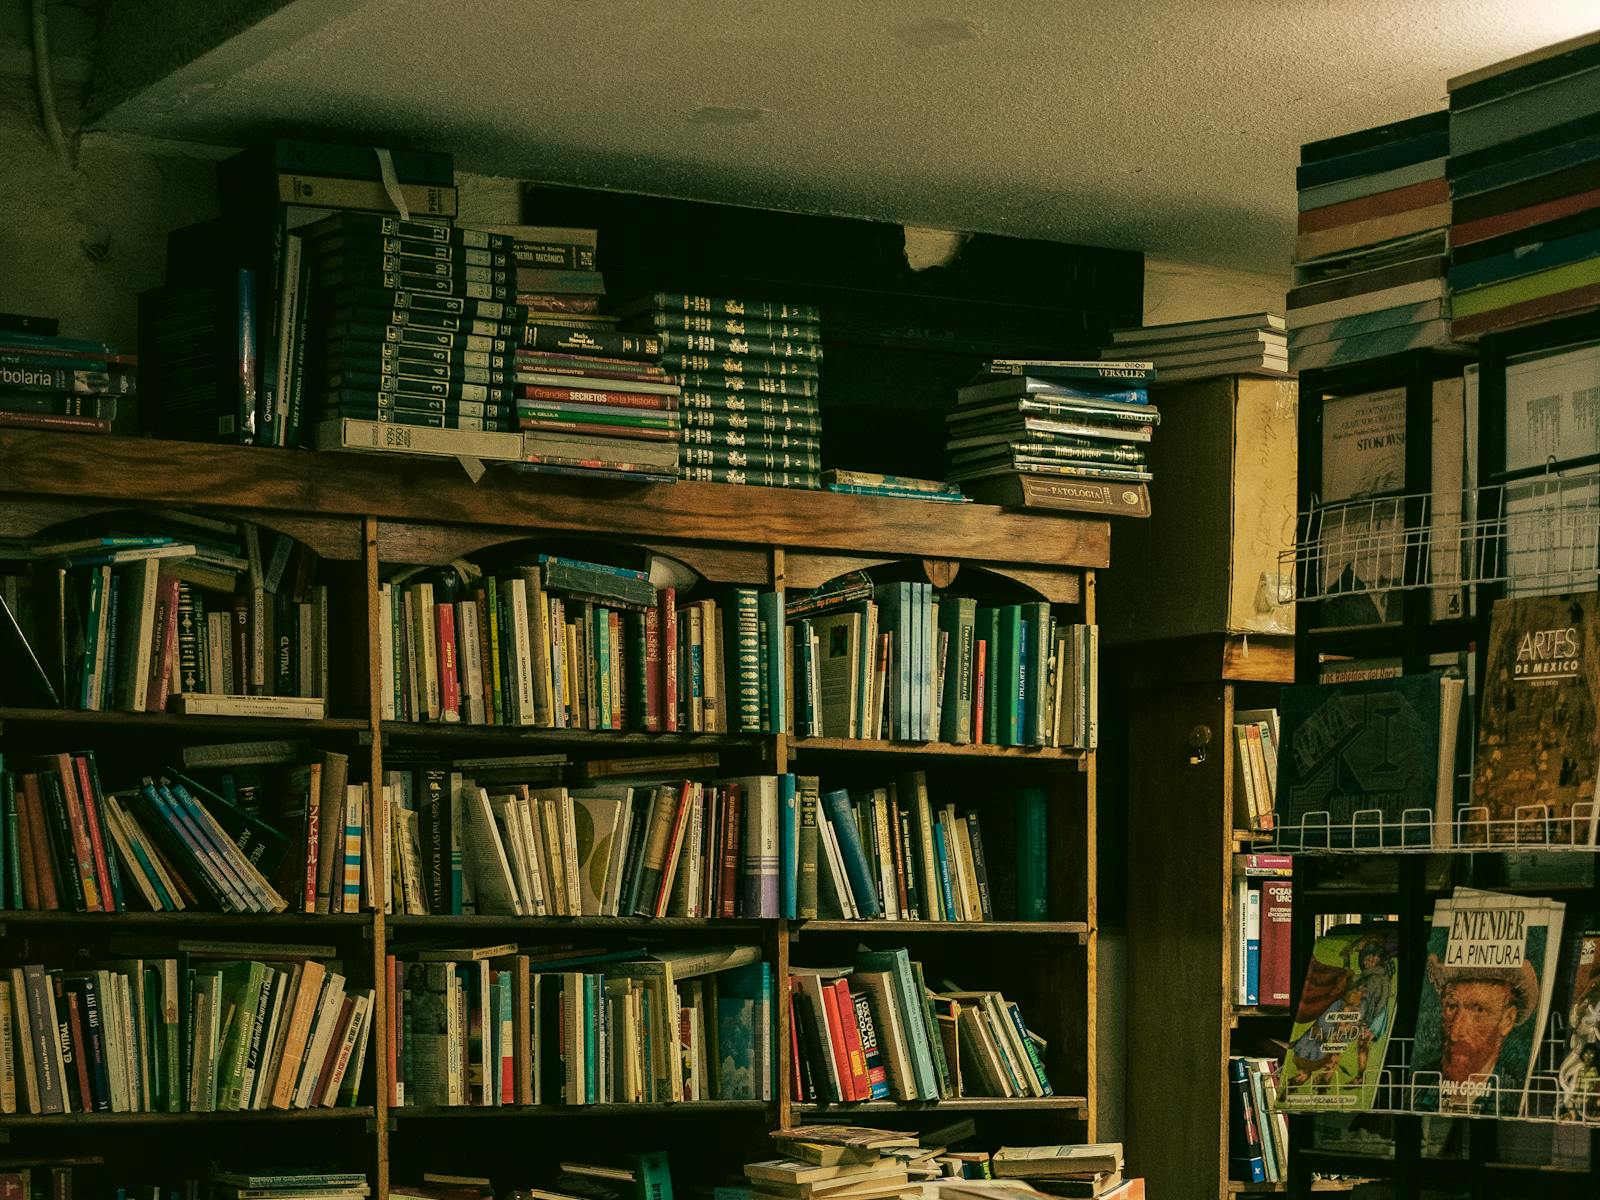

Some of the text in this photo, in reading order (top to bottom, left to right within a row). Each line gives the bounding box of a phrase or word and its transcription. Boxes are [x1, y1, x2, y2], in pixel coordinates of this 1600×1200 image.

[433, 229, 444, 240] 12
[435, 247, 446, 258] 11
[436, 264, 447, 275] 10
[437, 336, 448, 344] 6
[434, 352, 444, 360] 5
[434, 368, 444, 376] 4
[1098, 369, 1146, 379] VERSALLES
[535, 390, 569, 400] Grandes
[569, 391, 607, 403] SECRETOS
[626, 396, 658, 406] Historia
[963, 625, 971, 652] Tratado
[1516, 628, 1576, 661] ARTES
[280, 636, 289, 675] EL VITRAL
[1514, 660, 1579, 674] DE MEXICO
[431, 792, 441, 908] LA FUERZA DE LAS PALABRAS
[1450, 910, 1525, 941] ENTENDER
[1447, 945, 1521, 965] LA PINTURA
[86, 993, 99, 1027] LAST OASIS
[855, 1003, 871, 1050] ESCOLAR
[861, 1001, 878, 1047] OXFORD
[1309, 1026, 1323, 1041] LA
[59, 1022, 72, 1064] EL VITRAL
[233, 1012, 251, 1077] Historia universal
[1440, 1080, 1491, 1098] VAN GOGH
